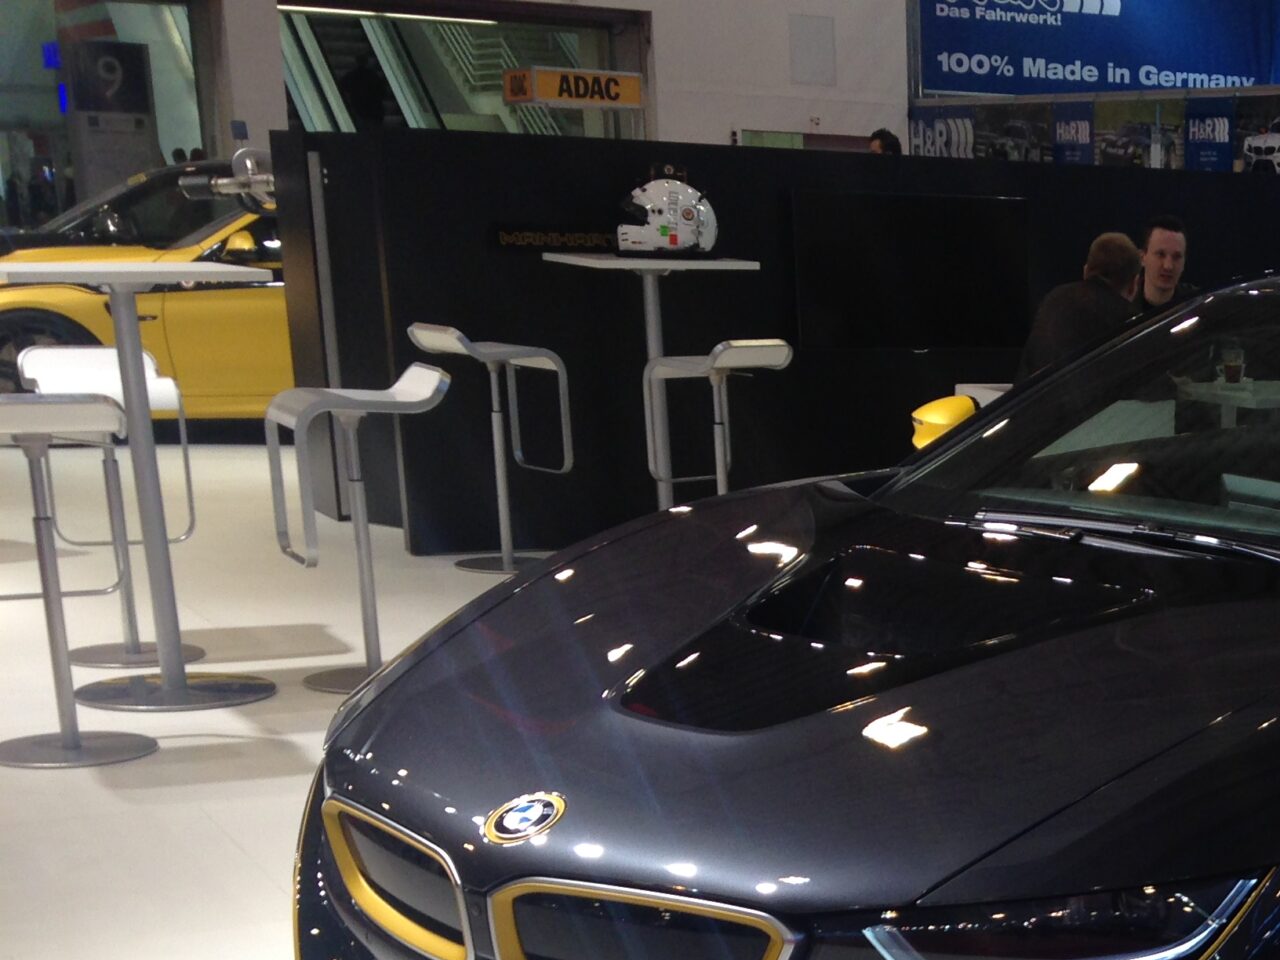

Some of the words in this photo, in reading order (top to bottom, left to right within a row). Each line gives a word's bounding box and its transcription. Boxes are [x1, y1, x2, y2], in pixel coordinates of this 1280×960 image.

[936, 3, 970, 18] Das
[975, 7, 1062, 26] Fahrwerk!
[98, 55, 122, 98] 9
[937, 51, 1014, 77] 100%
[1022, 57, 1099, 82] Made
[1107, 62, 1130, 84] in
[558, 74, 620, 100] ADAC
